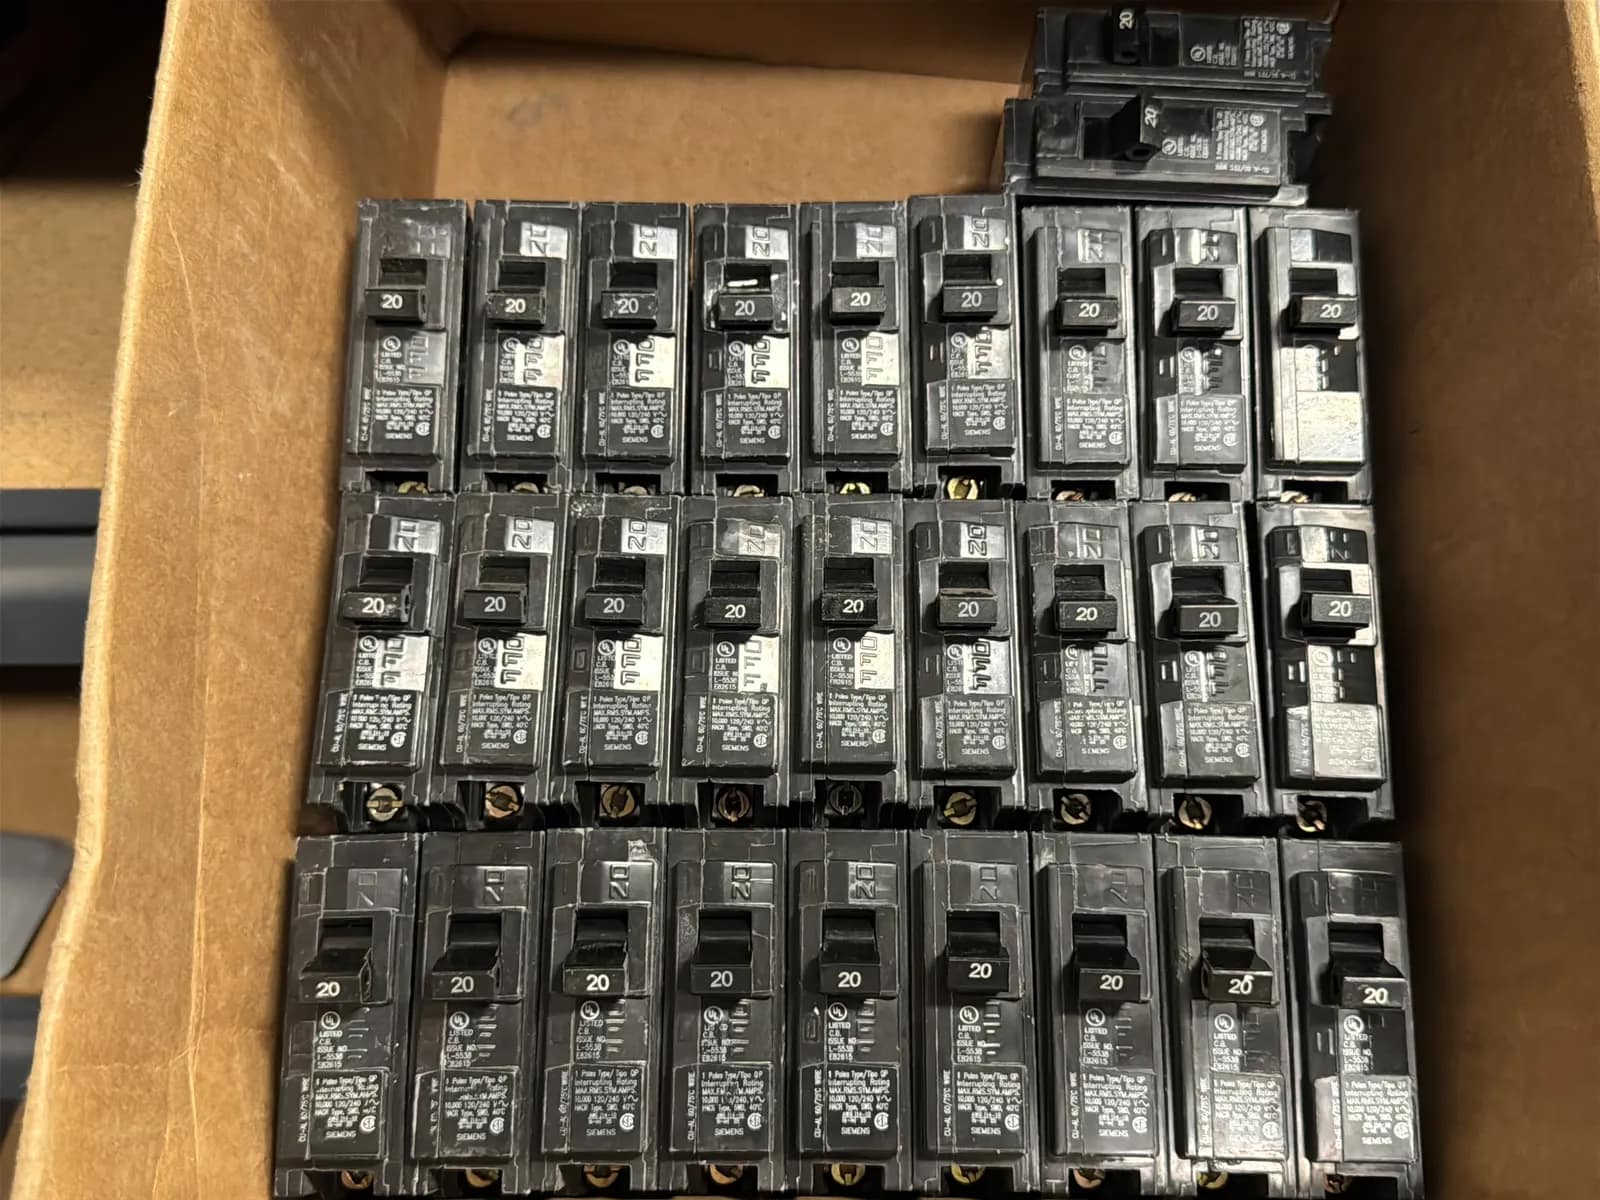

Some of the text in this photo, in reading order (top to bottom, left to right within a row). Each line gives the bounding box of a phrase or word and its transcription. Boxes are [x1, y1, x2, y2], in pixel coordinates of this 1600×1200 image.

[1119, 11, 1132, 29] 20
[1144, 107, 1158, 128] 20
[382, 294, 402, 309] 20
[505, 298, 526, 313] 20
[618, 299, 639, 314] 20
[850, 292, 871, 306] 20
[962, 291, 982, 307] 20
[735, 300, 755, 316] 20
[1079, 303, 1100, 317] 20
[1197, 305, 1218, 321] 20
[1320, 304, 1342, 318] 20
[362, 597, 385, 616] 20
[484, 596, 506, 612] 20
[603, 598, 624, 613] 20
[725, 604, 746, 618] 20
[843, 599, 864, 613] 20
[958, 602, 979, 617] 20
[1328, 600, 1352, 617] 20
[1076, 607, 1098, 621] 20
[1199, 612, 1221, 627] 20
[969, 963, 992, 978] 20
[451, 976, 474, 993] 20
[587, 974, 609, 991] 20
[711, 971, 733, 987] 20
[838, 972, 861, 987] 20
[1100, 975, 1123, 990] 20
[1229, 978, 1252, 994] 20
[316, 982, 340, 997] 20
[1363, 988, 1388, 1004] 20
